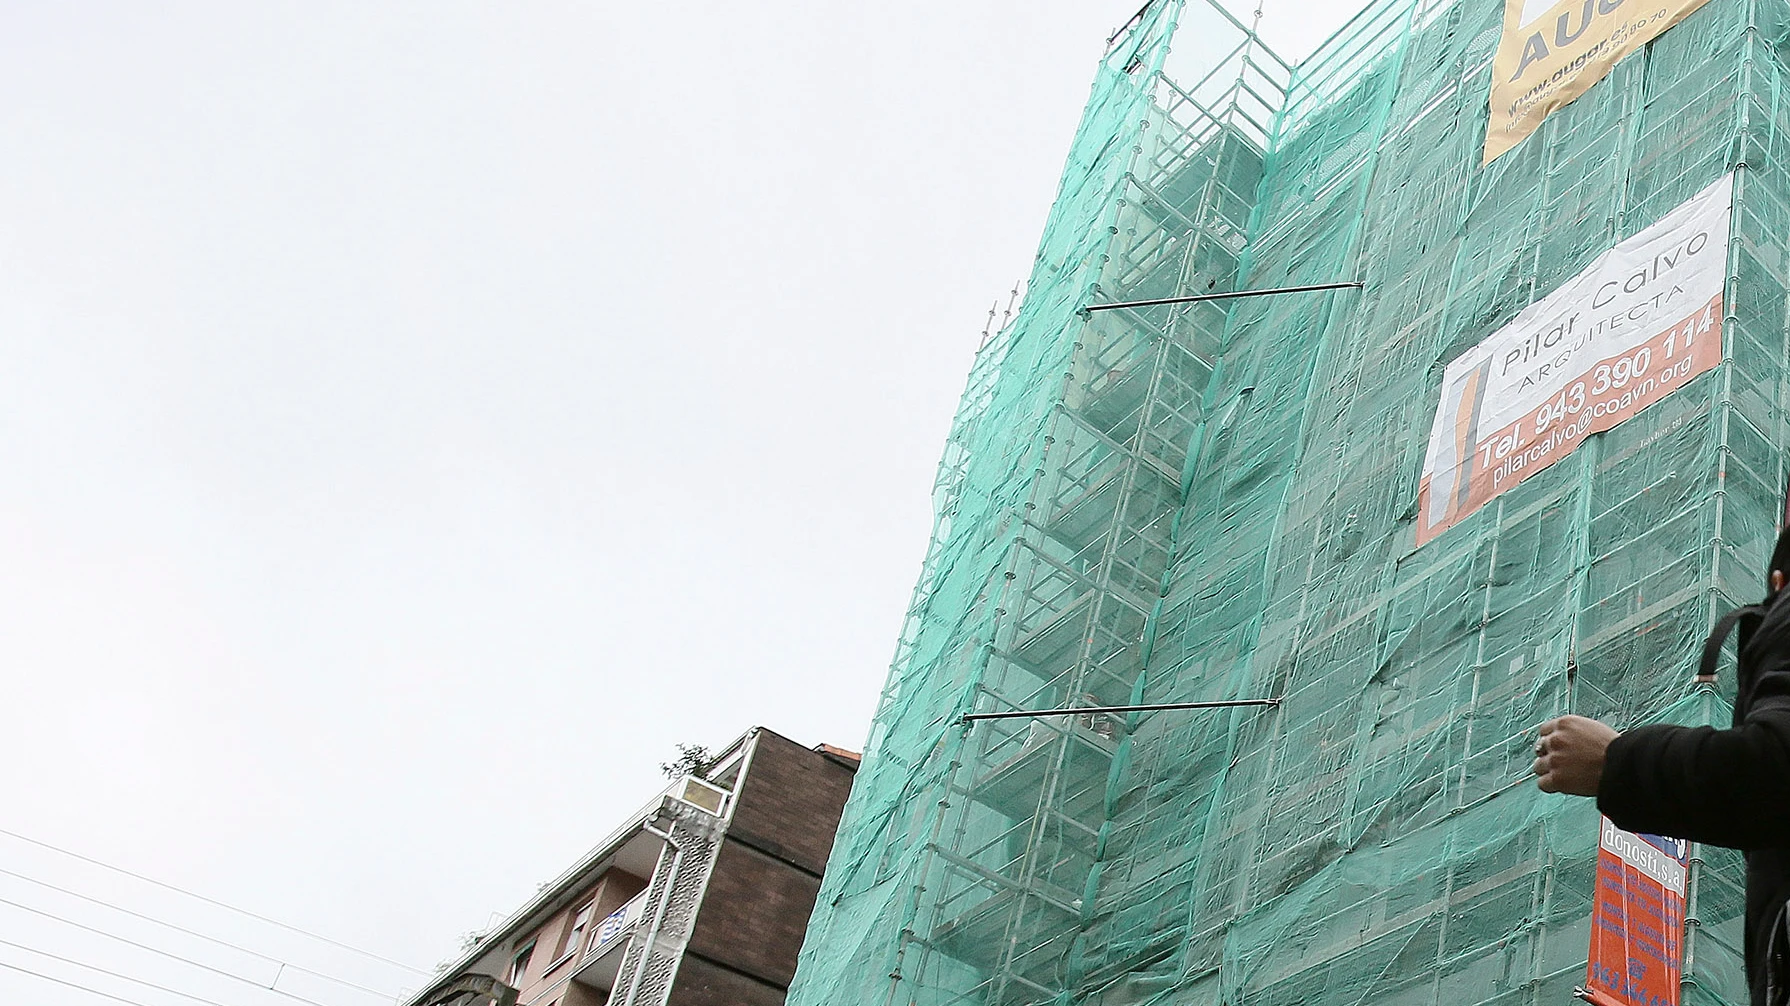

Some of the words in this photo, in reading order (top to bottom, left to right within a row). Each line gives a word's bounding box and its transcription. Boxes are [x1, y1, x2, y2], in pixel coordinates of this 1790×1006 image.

[1507, 0, 1627, 83] AU
[1650, 8, 1667, 23] 70
[1502, 311, 1580, 377] Pilar
[1592, 232, 1709, 310] Calvo
[1517, 284, 1684, 394] ARQUITECTA
[1478, 423, 1526, 470] Tel.
[1534, 381, 1586, 435] 943
[1592, 347, 1652, 397] 390
[1662, 303, 1714, 360] 114
[1493, 354, 1693, 490] pilarcalvo@coavn.org
